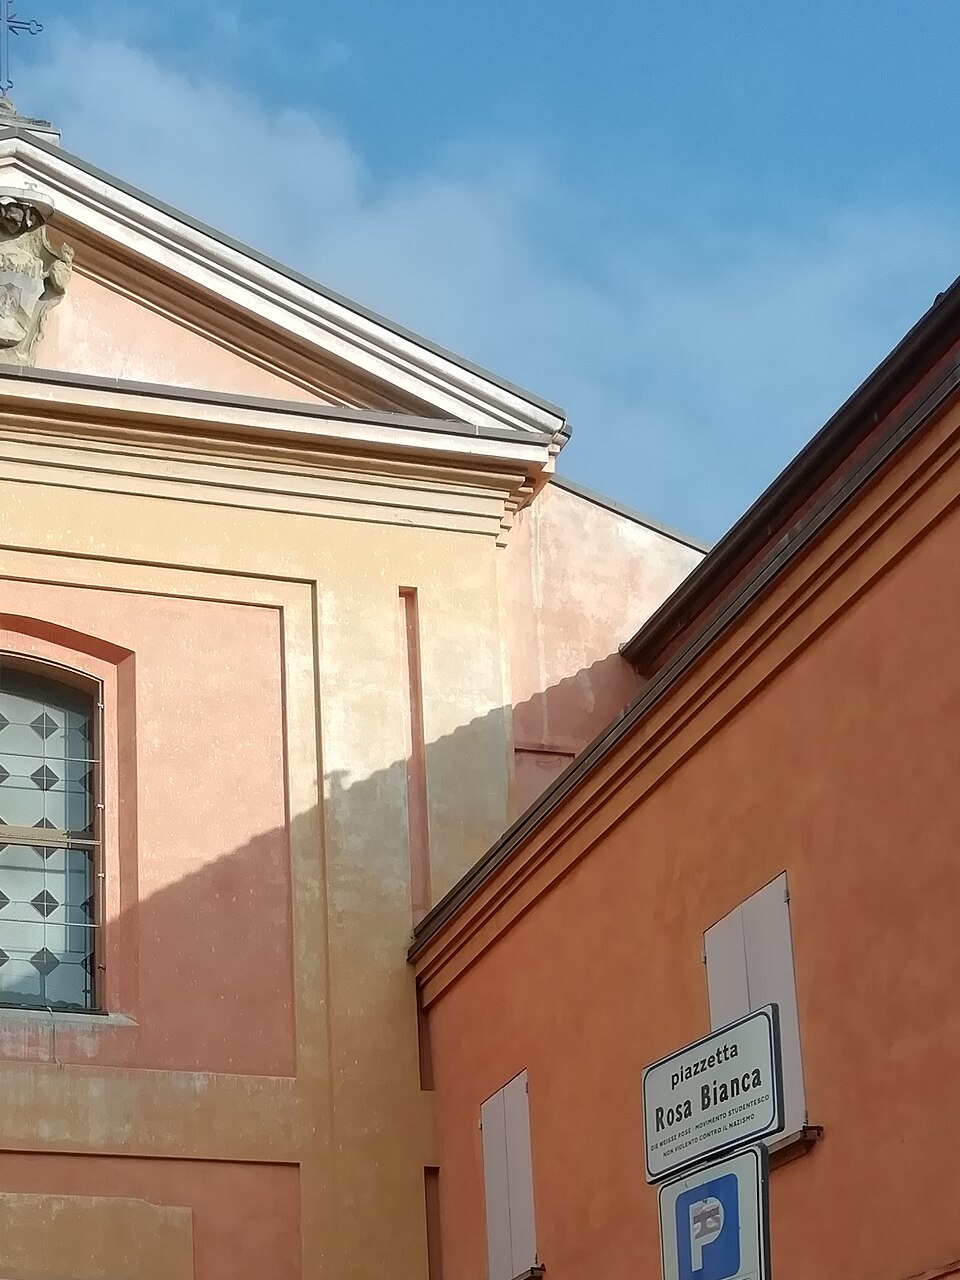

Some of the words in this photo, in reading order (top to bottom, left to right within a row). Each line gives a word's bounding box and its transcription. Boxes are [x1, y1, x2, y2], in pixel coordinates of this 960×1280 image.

[671, 1043, 739, 1090] piazzetta
[650, 1143, 659, 1151] DIE
[677, 1127, 692, 1139] ROSE
[694, 1112, 727, 1130] MOVIMENTO
[727, 1094, 770, 1117] STUDENTESCO
[655, 1099, 693, 1132] Rosa
[700, 1067, 762, 1111] Bianca
[662, 1148, 674, 1157] NON
[674, 1137, 699, 1152] VIOLENTO
[698, 1127, 722, 1141] CONTRO
[728, 1113, 755, 1129] NAZISMO
